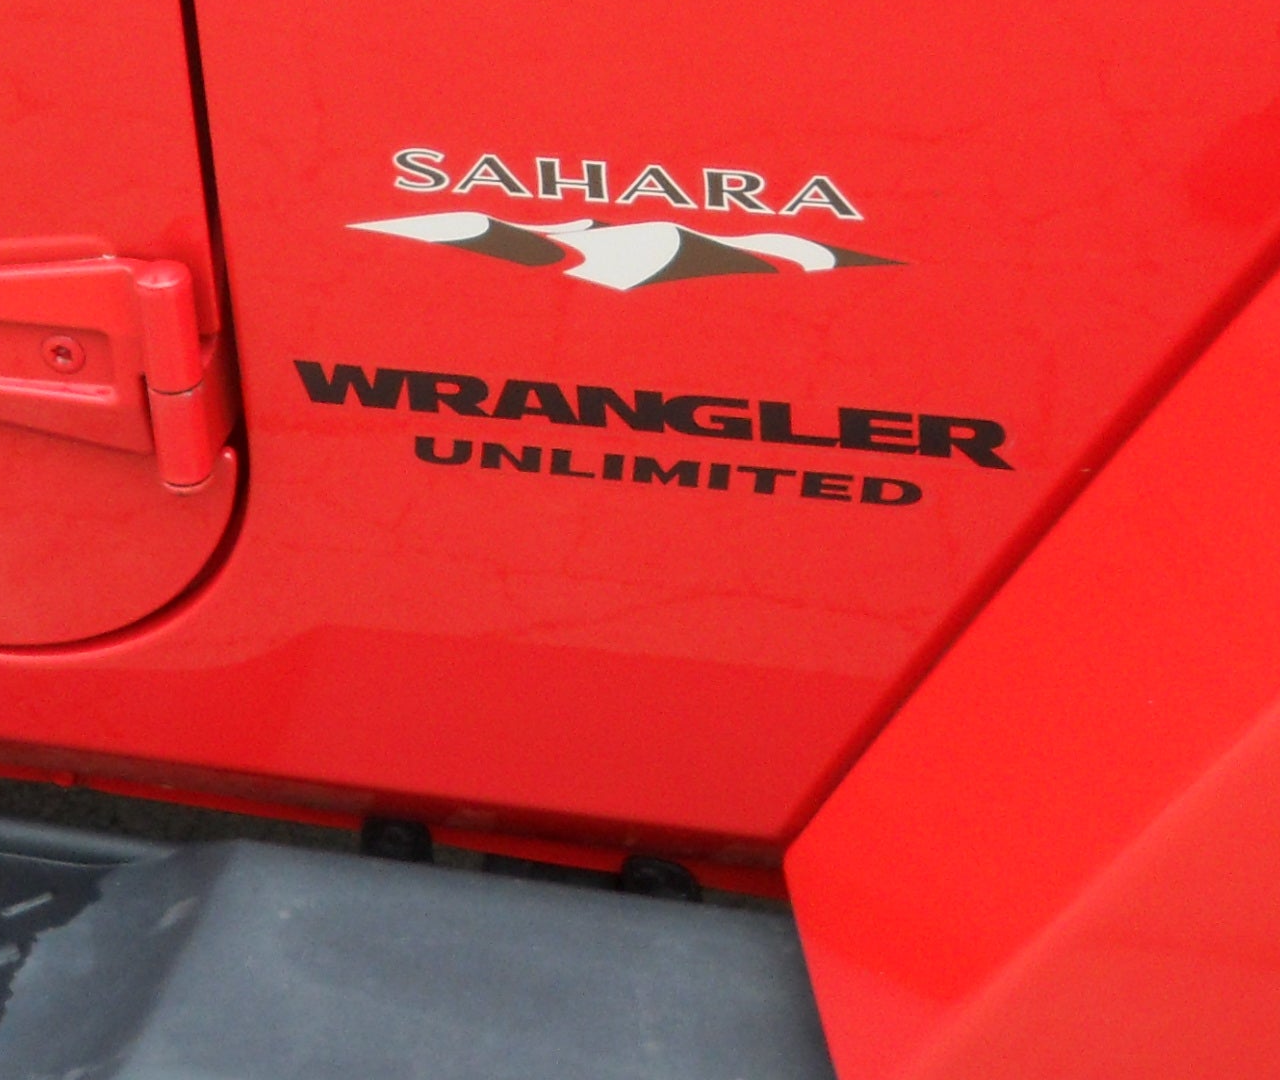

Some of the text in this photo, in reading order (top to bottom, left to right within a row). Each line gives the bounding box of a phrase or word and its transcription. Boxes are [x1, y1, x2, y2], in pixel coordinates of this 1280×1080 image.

[391, 147, 864, 220] SAHARA
[292, 360, 1016, 471] WRANGLER
[413, 435, 923, 507] UNLIMITED
